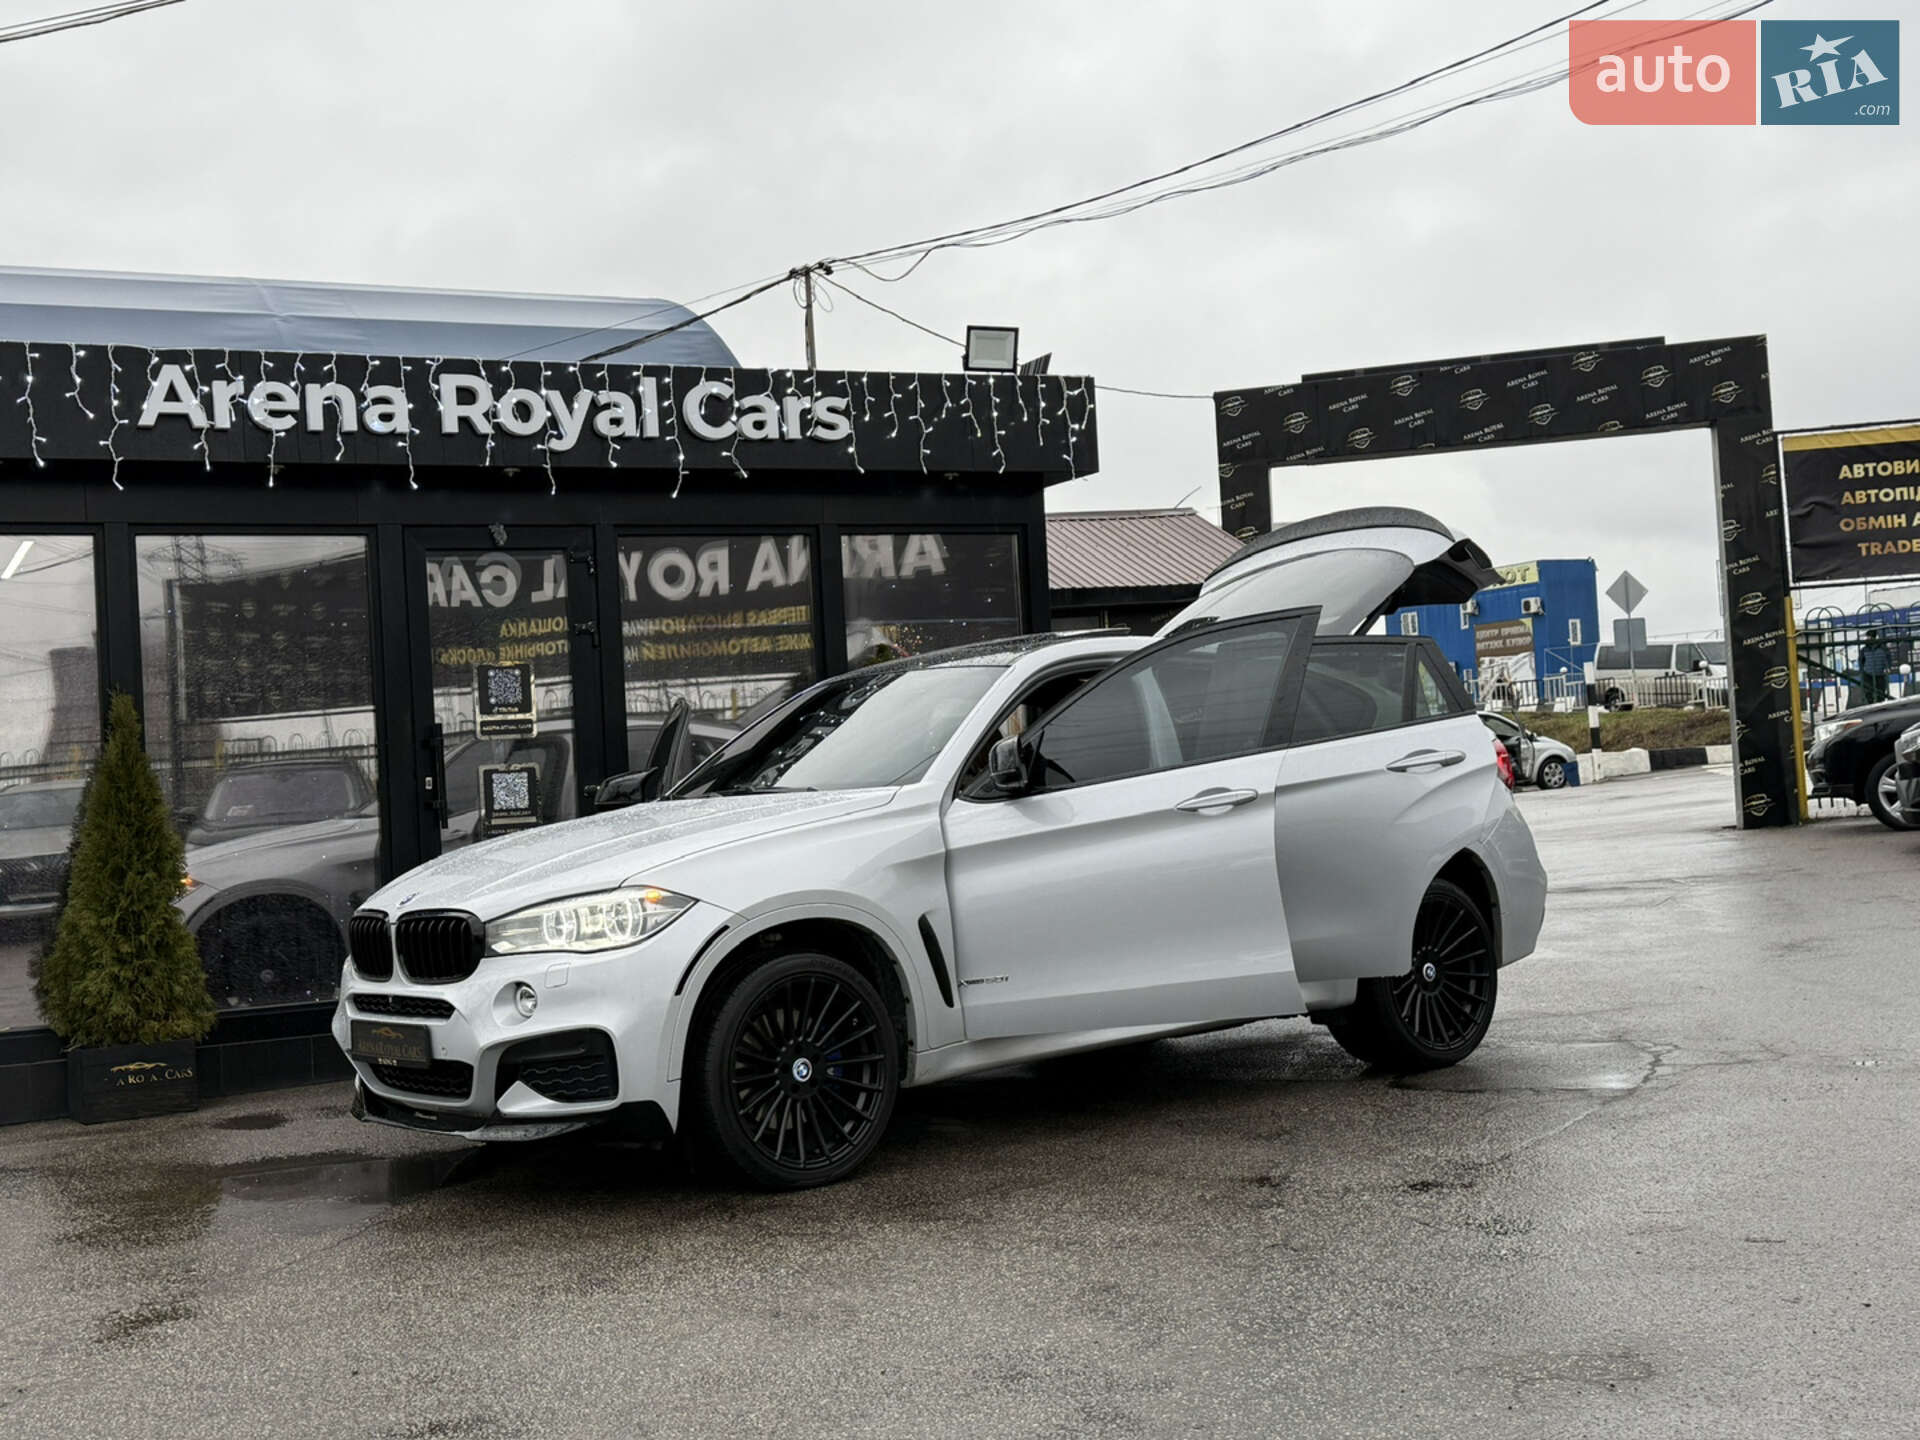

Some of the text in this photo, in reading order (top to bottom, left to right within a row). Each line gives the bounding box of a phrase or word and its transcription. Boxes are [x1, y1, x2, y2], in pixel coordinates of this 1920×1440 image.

[137, 364, 851, 452] Arena Royal Cars
[1839, 513, 1907, 532] ОБМІН
